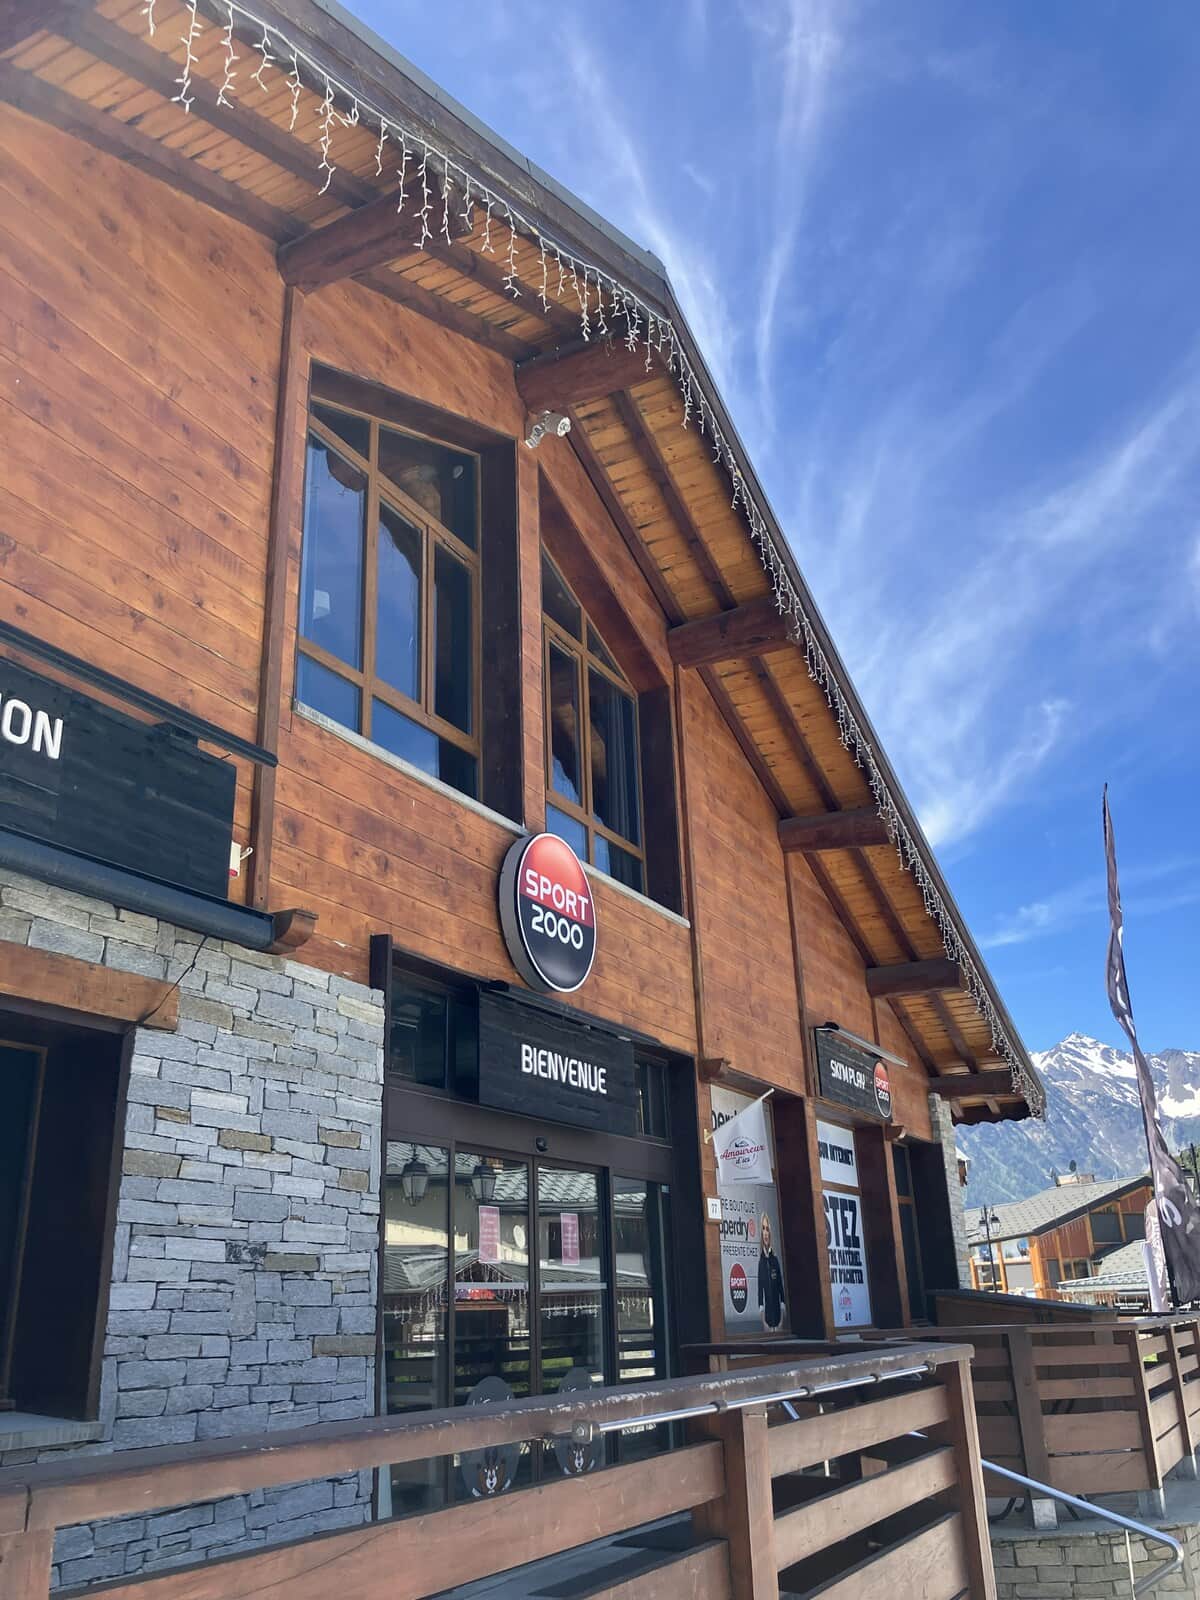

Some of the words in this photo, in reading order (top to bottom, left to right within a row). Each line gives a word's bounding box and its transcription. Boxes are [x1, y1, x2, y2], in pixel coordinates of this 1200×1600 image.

[0, 693, 63, 759] ON
[525, 868, 589, 920] SPORT
[531, 903, 584, 950] 2000
[521, 1043, 607, 1094] BIENVENUE
[875, 1076, 889, 1091] SPORT
[878, 1088, 890, 1102] 2000
[729, 1199, 755, 1214] BOUTIQUE
[730, 1277, 746, 1288] SPORT
[733, 1290, 745, 1300] 2000
